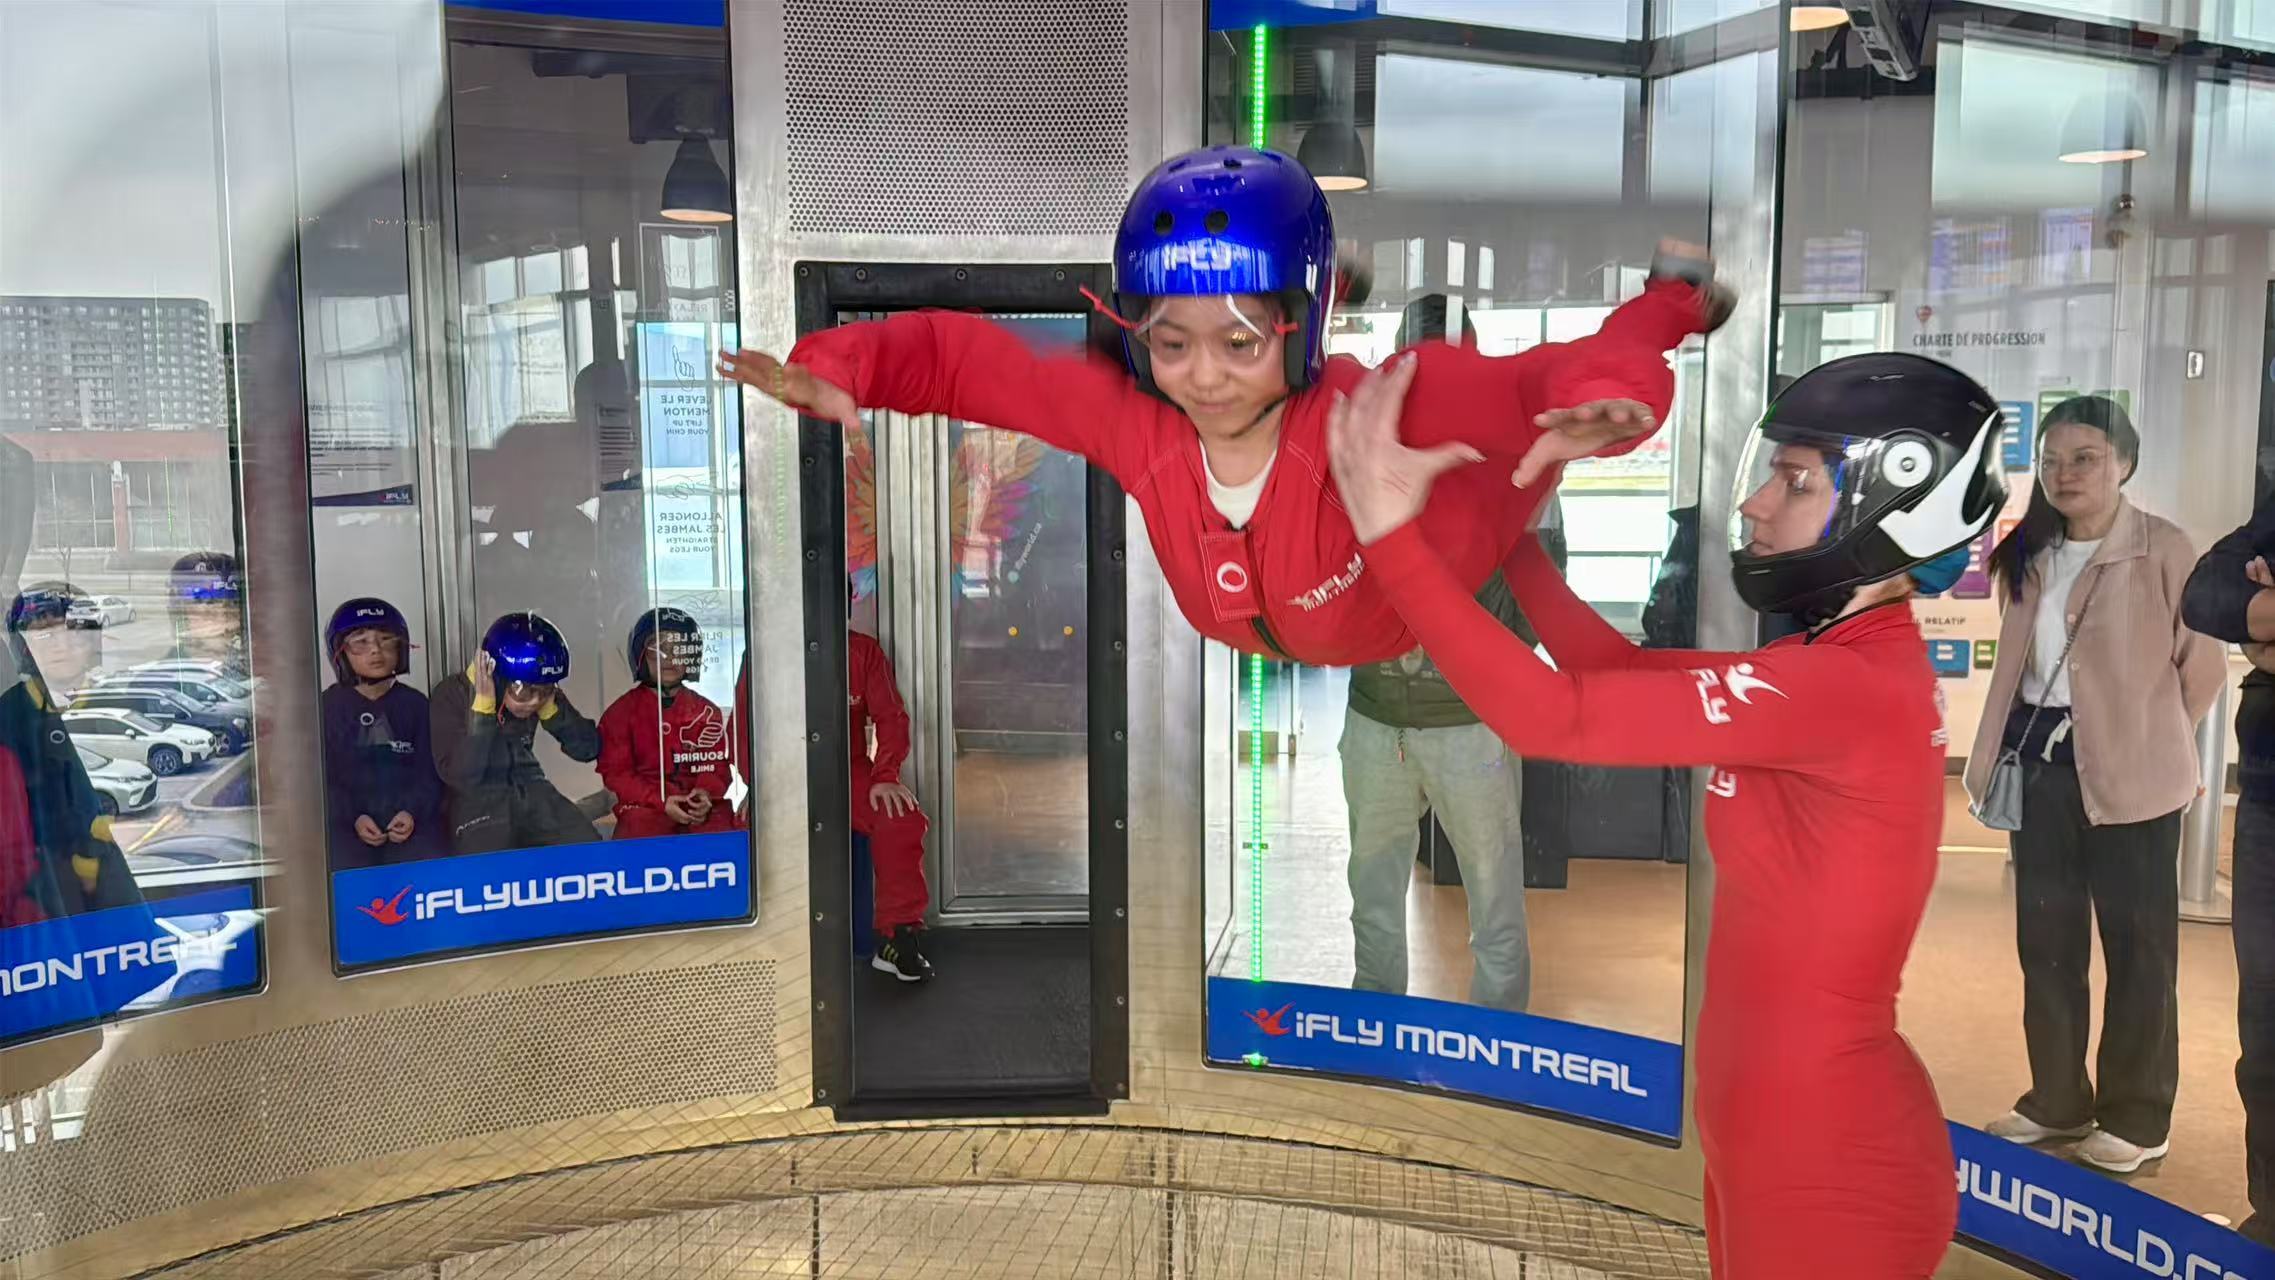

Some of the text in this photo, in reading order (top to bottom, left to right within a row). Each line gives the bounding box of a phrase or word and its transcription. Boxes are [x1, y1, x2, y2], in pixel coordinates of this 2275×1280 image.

[1913, 332, 1953, 347] CHARTE
[1971, 332, 2046, 347] PROGRESSION
[1924, 616, 1966, 625] RELATIF
[415, 861, 736, 921] iFLYWORLD.CA
[1295, 1010, 1648, 1098] iFLY MONTREAL
